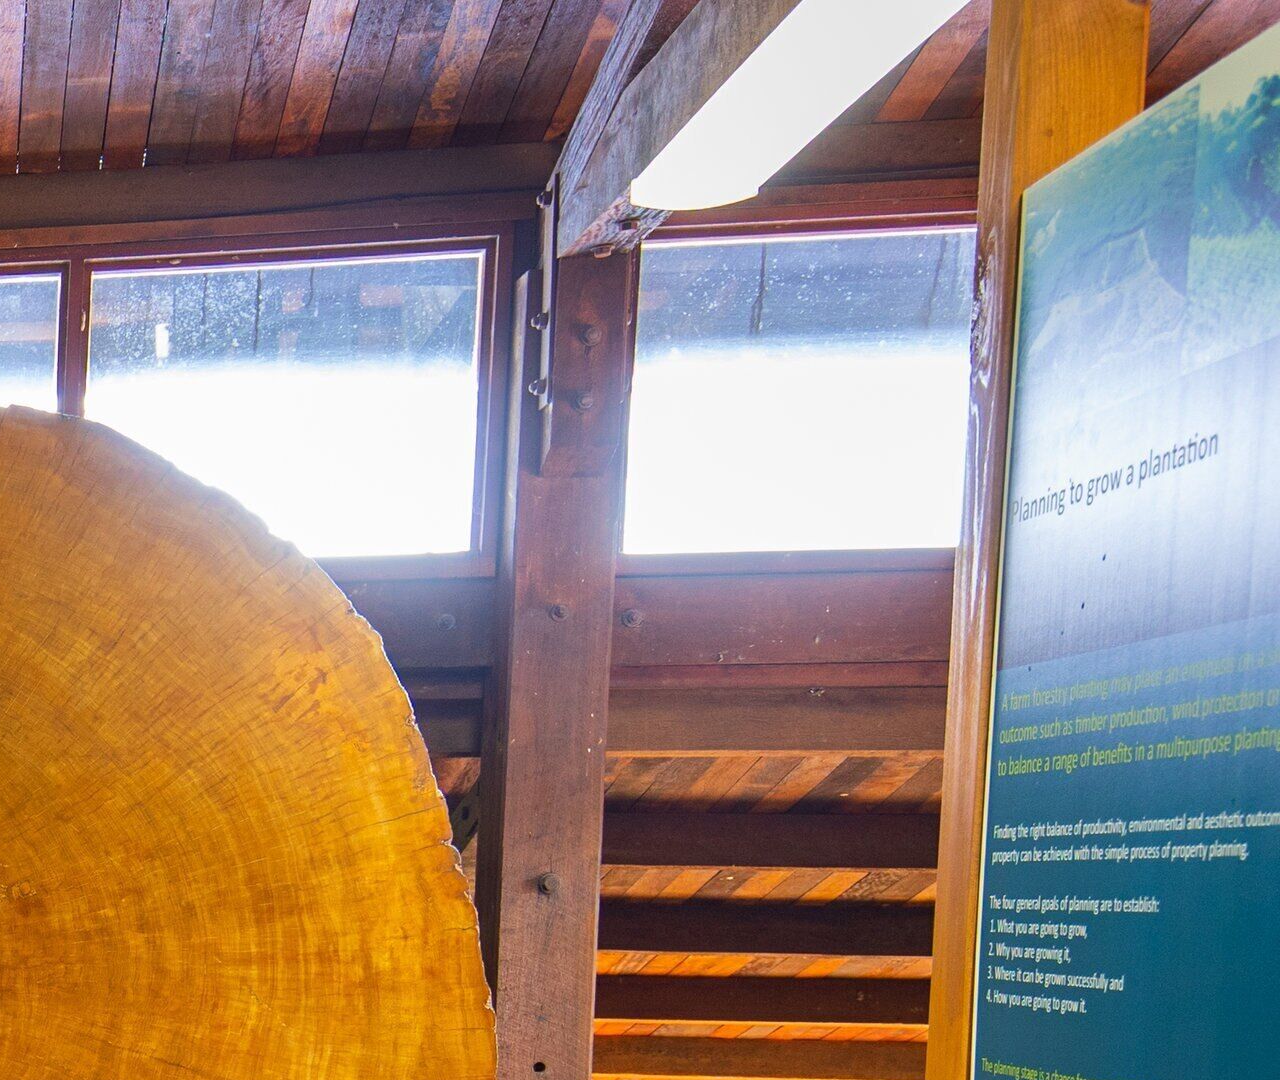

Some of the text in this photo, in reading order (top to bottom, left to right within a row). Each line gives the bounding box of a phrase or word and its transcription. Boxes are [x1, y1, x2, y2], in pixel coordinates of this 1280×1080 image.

[1011, 432, 1218, 525] Planning to grow a plantation
[998, 760, 1006, 776] to
[1009, 754, 1042, 775] balance
[1044, 757, 1049, 771] a
[1052, 754, 1078, 774] range
[1081, 746, 1091, 767] of
[1093, 742, 1132, 766] benefits
[1135, 740, 1144, 761] in
[1147, 745, 1153, 760] a
[1156, 735, 1232, 761] multipurpose
[990, 895, 1160, 915] The four general goals of planning are to establish:
[990, 919, 1087, 939] 1. What you are going to grow,
[988, 943, 994, 956] 2.
[996, 943, 1010, 959] Why
[1011, 947, 1023, 960] you
[1024, 948, 1035, 959] are
[1035, 946, 1063, 964] growing
[987, 966, 1124, 993] 3. Where it can be grown successfully and
[986, 989, 992, 1003] 4.
[993, 990, 1008, 1004] How
[1009, 994, 1021, 1008] you
[1021, 995, 1032, 1006] are
[1033, 994, 1051, 1013] going
[1052, 997, 1060, 1010] to
[1061, 1000, 1078, 1014] grow
